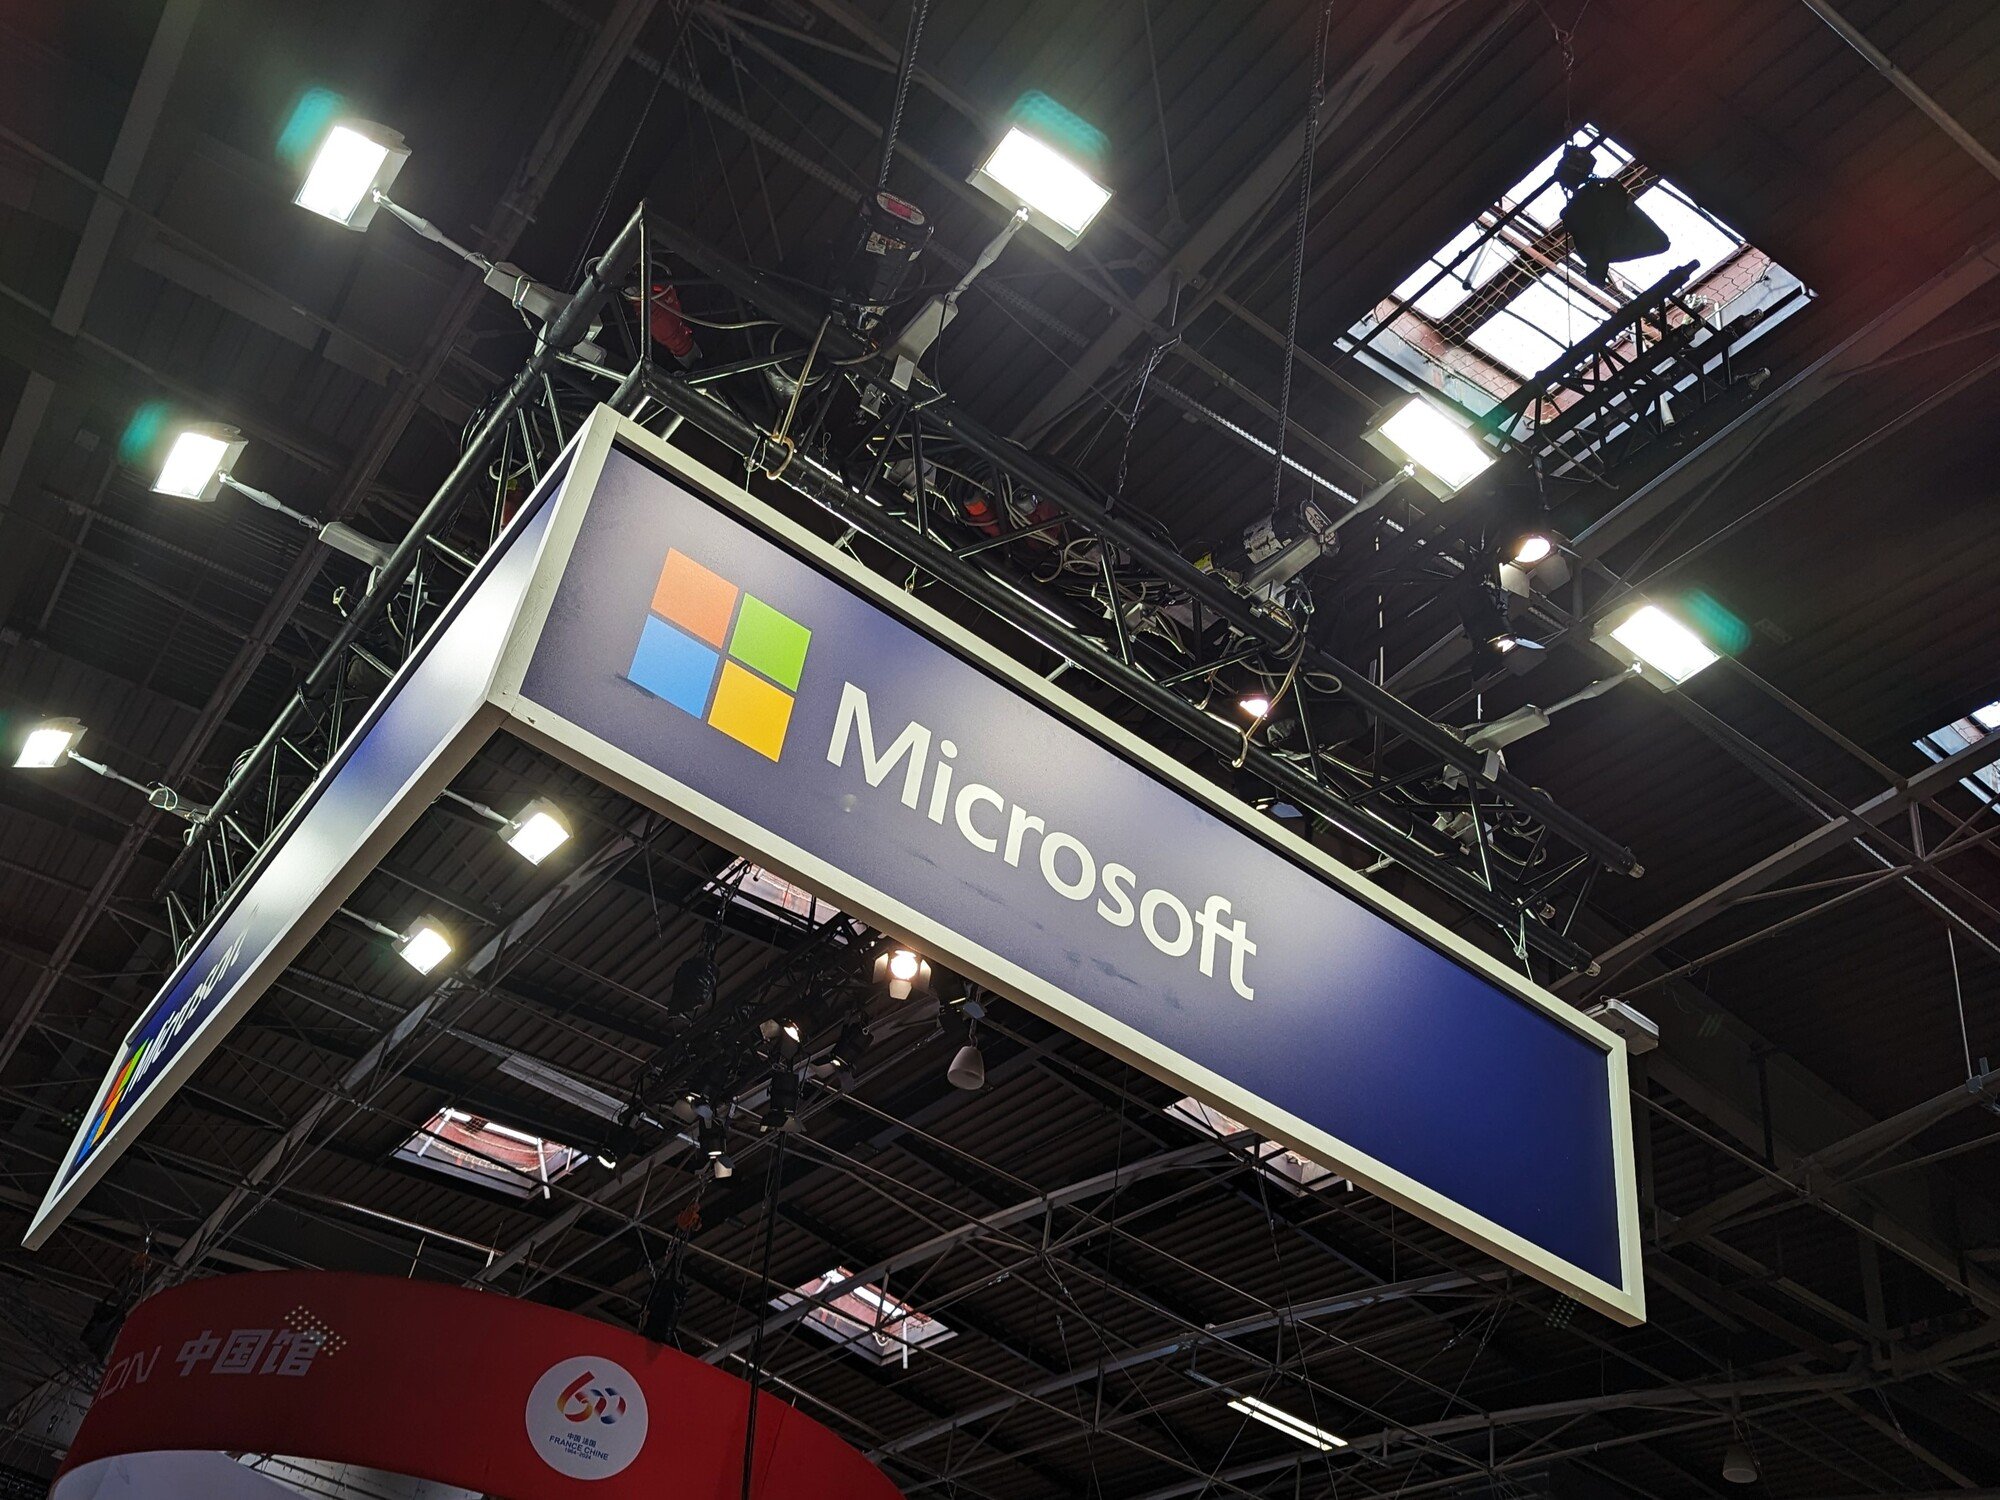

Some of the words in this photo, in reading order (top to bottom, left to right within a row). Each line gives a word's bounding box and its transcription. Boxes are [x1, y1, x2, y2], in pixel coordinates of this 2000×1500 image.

[826, 681, 1257, 1001] Microsoft
[175, 1329, 325, 1377] 中国馆
[549, 1434, 583, 1452] FRANCE
[583, 1446, 609, 1461] CHINE
